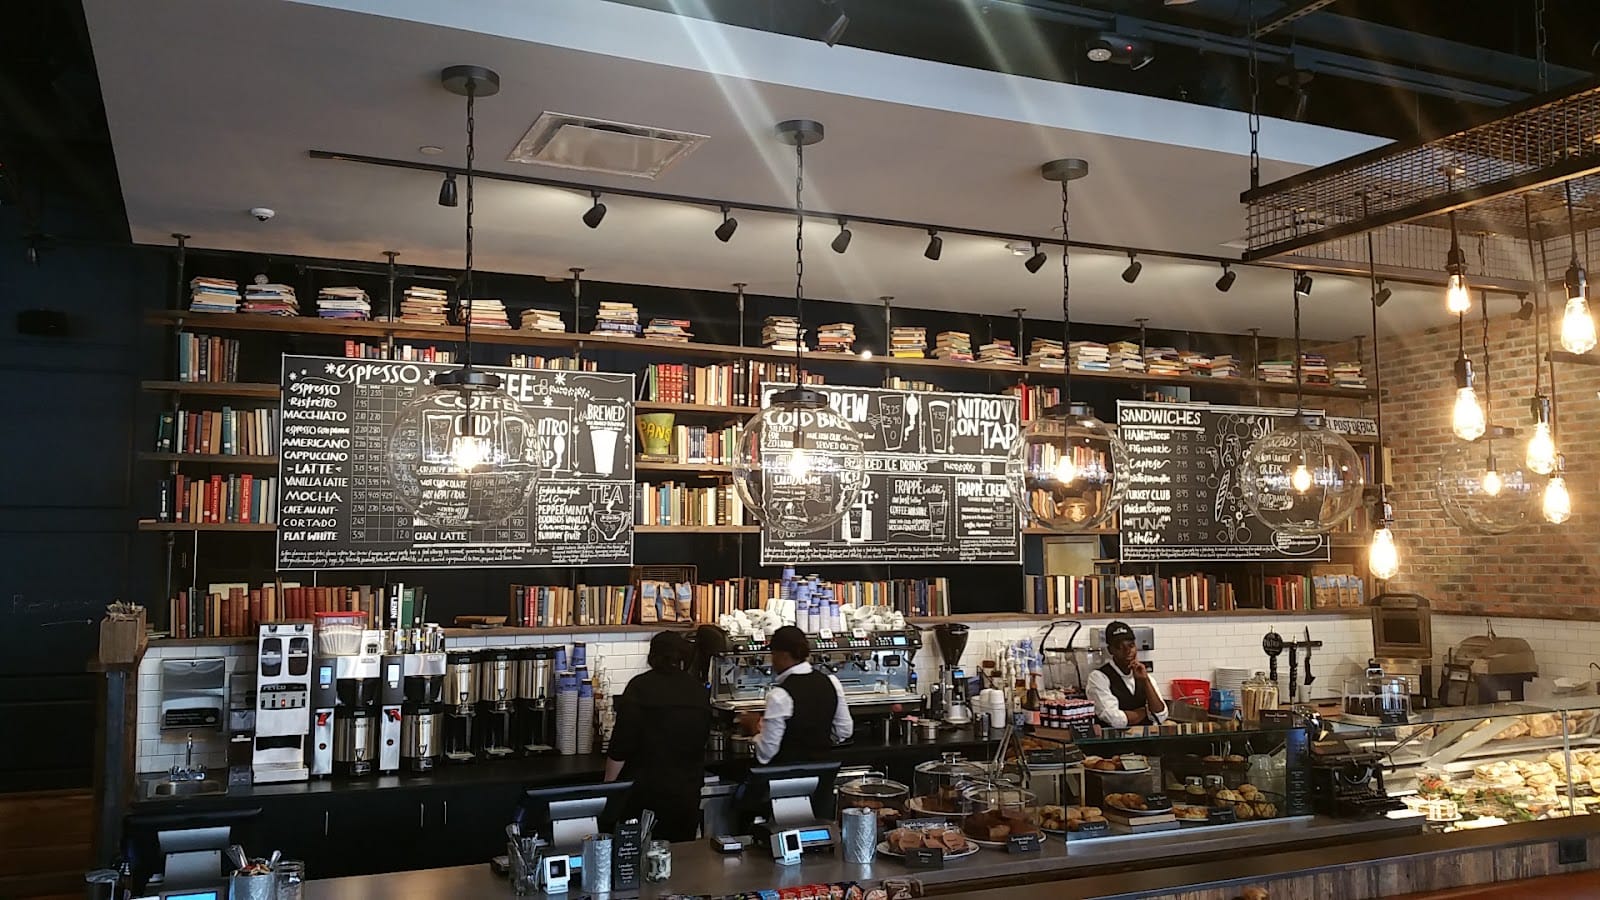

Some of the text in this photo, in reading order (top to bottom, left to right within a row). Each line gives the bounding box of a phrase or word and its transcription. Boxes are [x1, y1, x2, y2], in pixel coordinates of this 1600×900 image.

[587, 403, 626, 422] BREWED
[957, 397, 1001, 420] NITRO
[283, 410, 347, 422] MACCHIATO
[1121, 408, 1201, 425] SANDWICHES
[957, 419, 979, 436] ON
[980, 420, 1016, 449] TAP
[282, 437, 350, 449] AMERICANO
[284, 451, 348, 462] CAPPUCCINO
[884, 458, 898, 471] ICE
[899, 459, 928, 473] DRINKS
[284, 477, 348, 488] VANILLA LATTE
[285, 490, 343, 503] MOCHA
[587, 484, 624, 505] TEA
[1150, 489, 1170, 500] CLUB
[538, 504, 589, 516] PEPPERMINT
[282, 518, 337, 528] CORTADO
[1132, 517, 1166, 530] TUNA
[283, 531, 338, 541] FLAT WHITE
[414, 532, 467, 541] CHAI LATTE
